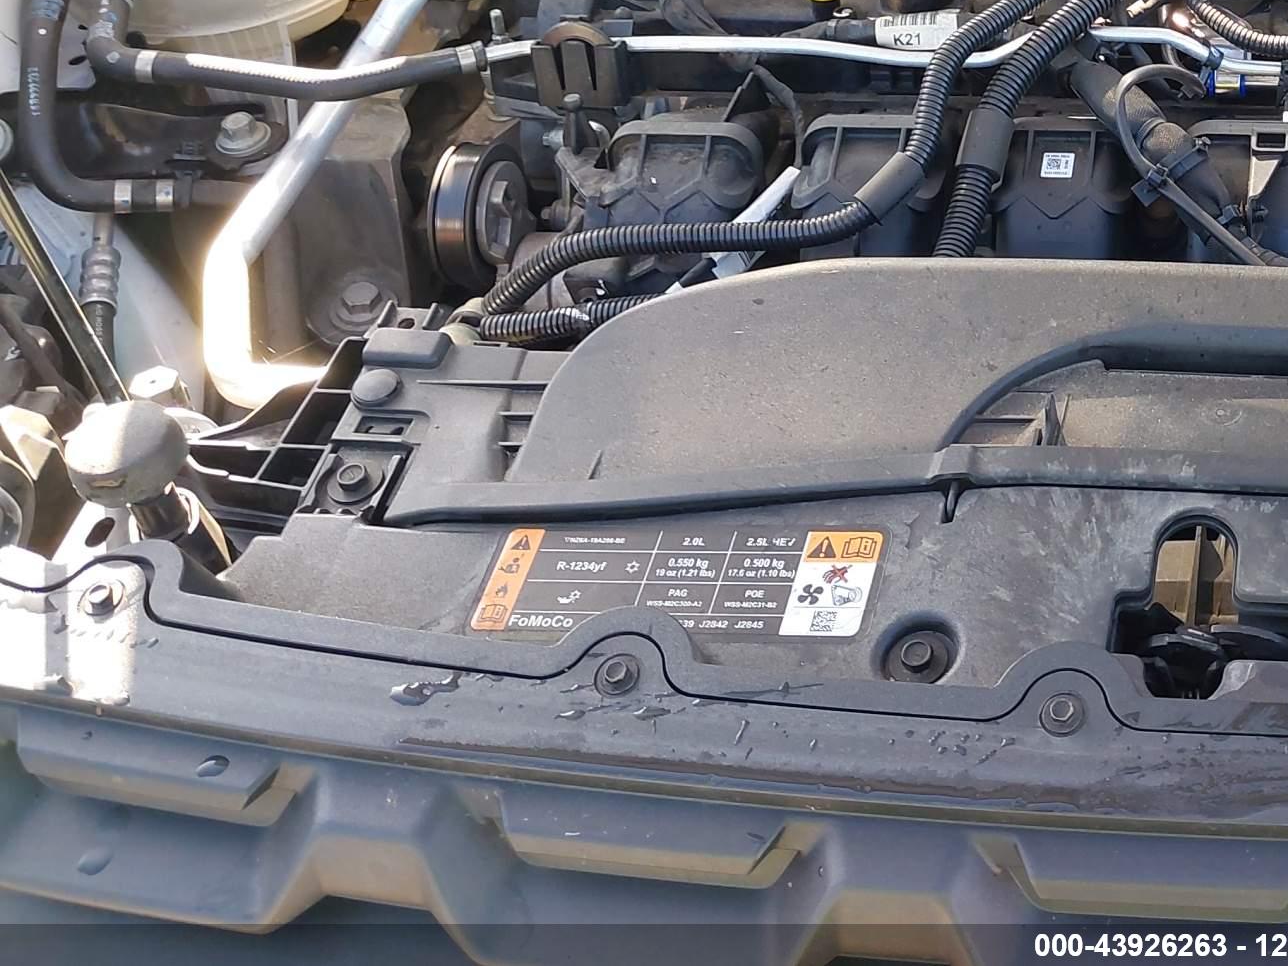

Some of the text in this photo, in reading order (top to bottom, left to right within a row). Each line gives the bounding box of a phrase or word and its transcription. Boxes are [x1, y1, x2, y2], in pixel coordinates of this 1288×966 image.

[892, 32, 922, 46] K21
[682, 537, 705, 546] 2.0L
[746, 537, 768, 546] 2.5L
[556, 560, 608, 574] R-1234yf
[668, 558, 710, 569] 0.550 kg
[743, 558, 786, 570] 0.500 kg
[655, 569, 666, 577] 19
[668, 589, 689, 597] PAG
[744, 590, 765, 598] POE
[508, 614, 574, 628] FoMoCo
[698, 620, 729, 629] J2842
[734, 621, 764, 629] J2845
